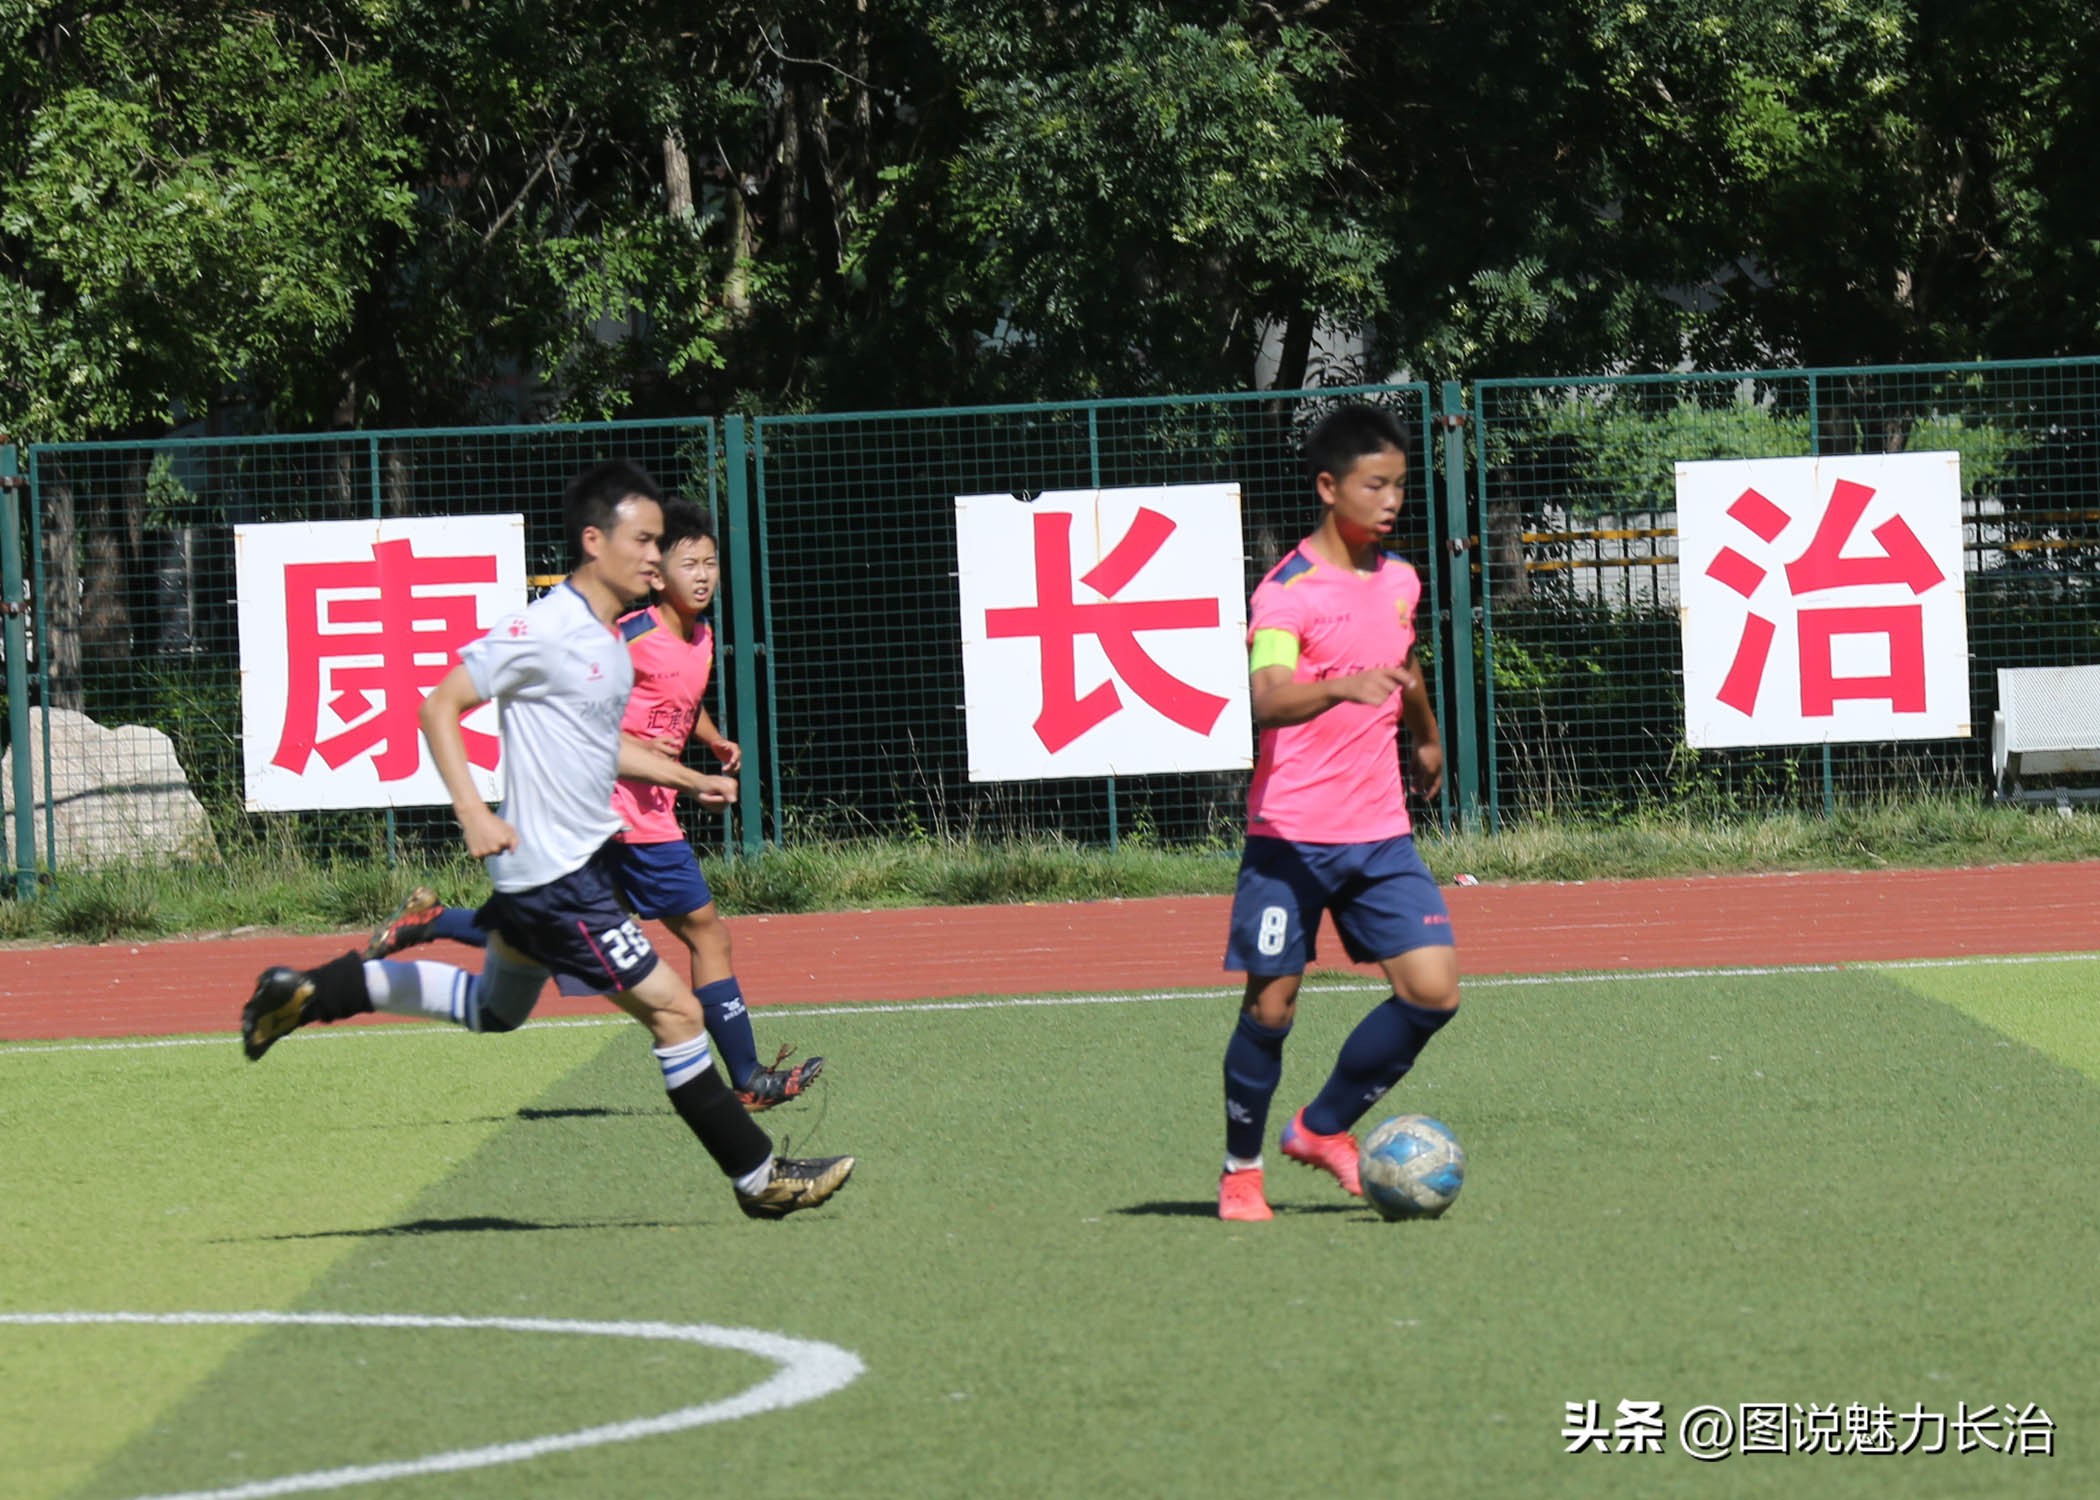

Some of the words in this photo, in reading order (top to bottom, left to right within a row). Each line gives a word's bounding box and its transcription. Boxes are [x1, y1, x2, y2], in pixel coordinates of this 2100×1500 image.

[272, 538, 500, 782] 康
[986, 506, 1230, 754] 长
[1705, 478, 1944, 717] 治
[1257, 906, 1288, 956] 8
